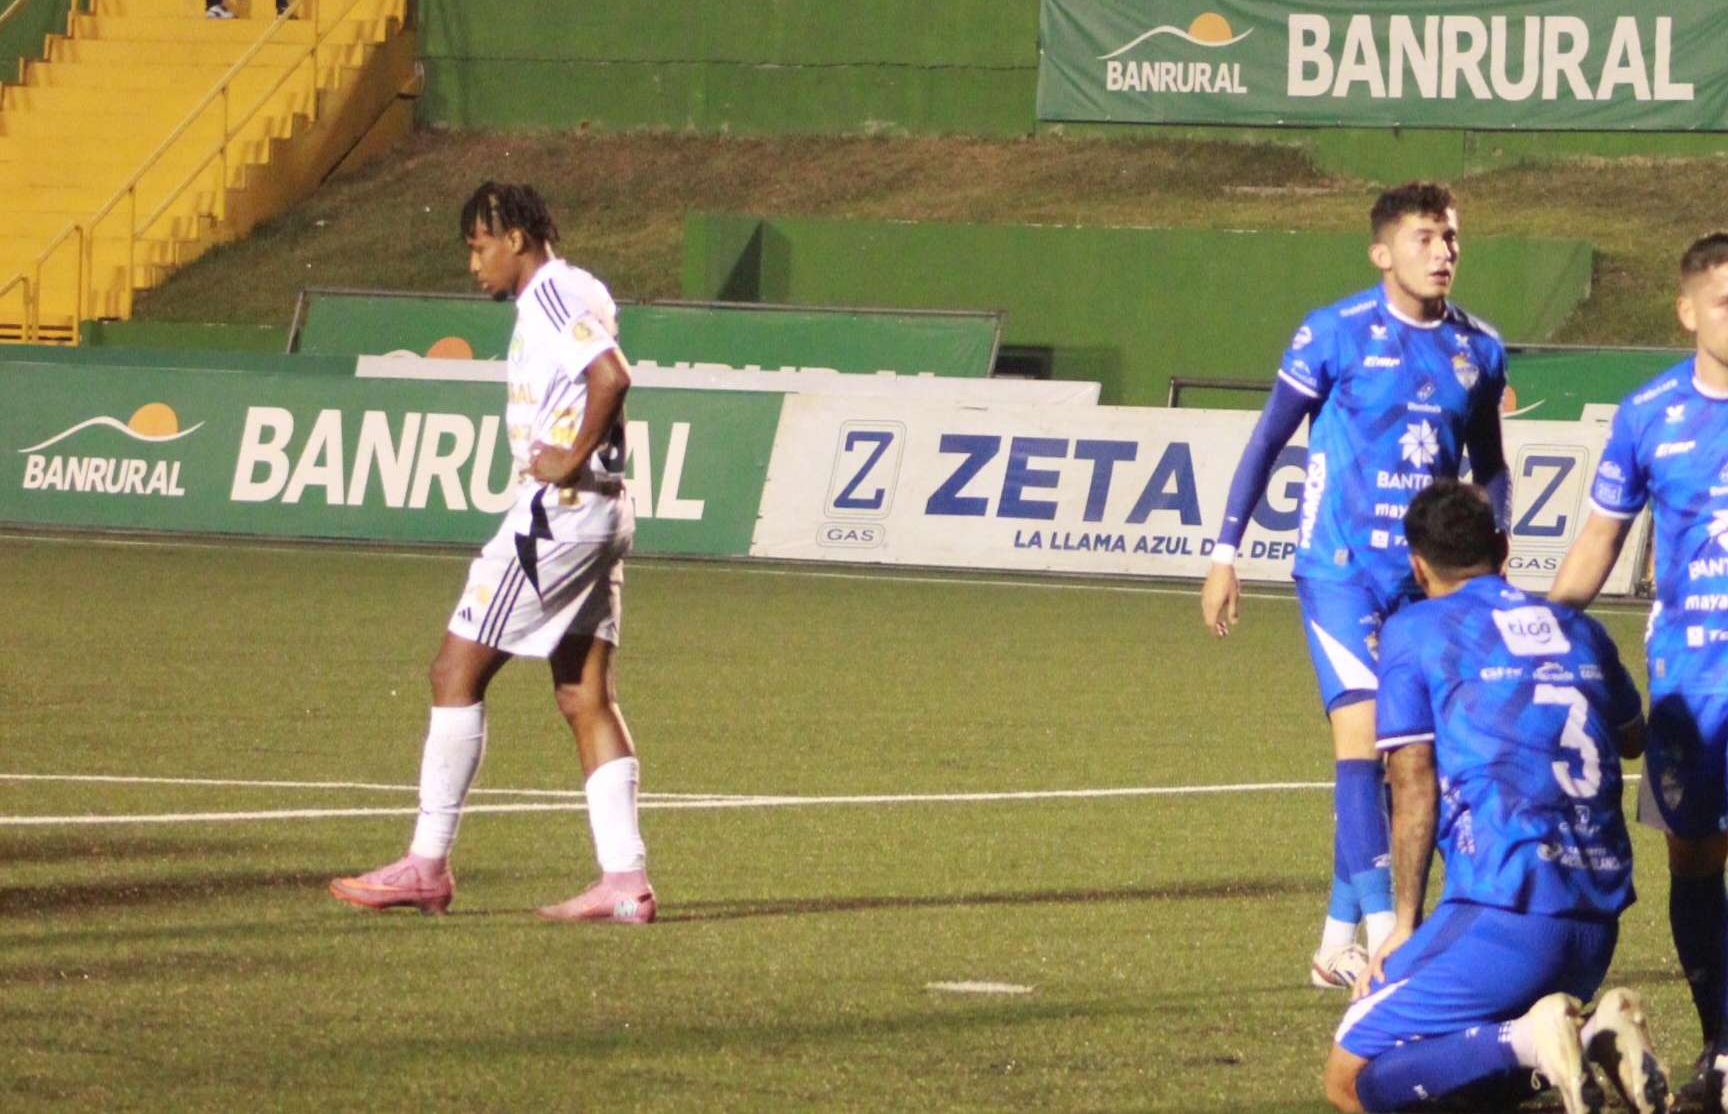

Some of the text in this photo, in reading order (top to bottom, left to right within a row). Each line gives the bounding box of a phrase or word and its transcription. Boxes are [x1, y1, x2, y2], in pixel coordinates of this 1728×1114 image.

[1106, 61, 1248, 94] BANRURAL
[1286, 13, 1695, 102] BANRURAL
[22, 453, 186, 497] BANRURAL
[229, 405, 706, 520] BANRUAL
[832, 430, 895, 510] Z
[925, 433, 1202, 526] ZETA
[1512, 455, 1576, 537] Z
[826, 528, 876, 544] GAS
[1014, 530, 1043, 549] LA
[1050, 531, 1126, 553] LLAMA
[1132, 535, 1193, 555] AZUL
[1507, 556, 1557, 570] GAS
[1533, 683, 1602, 799] 3
